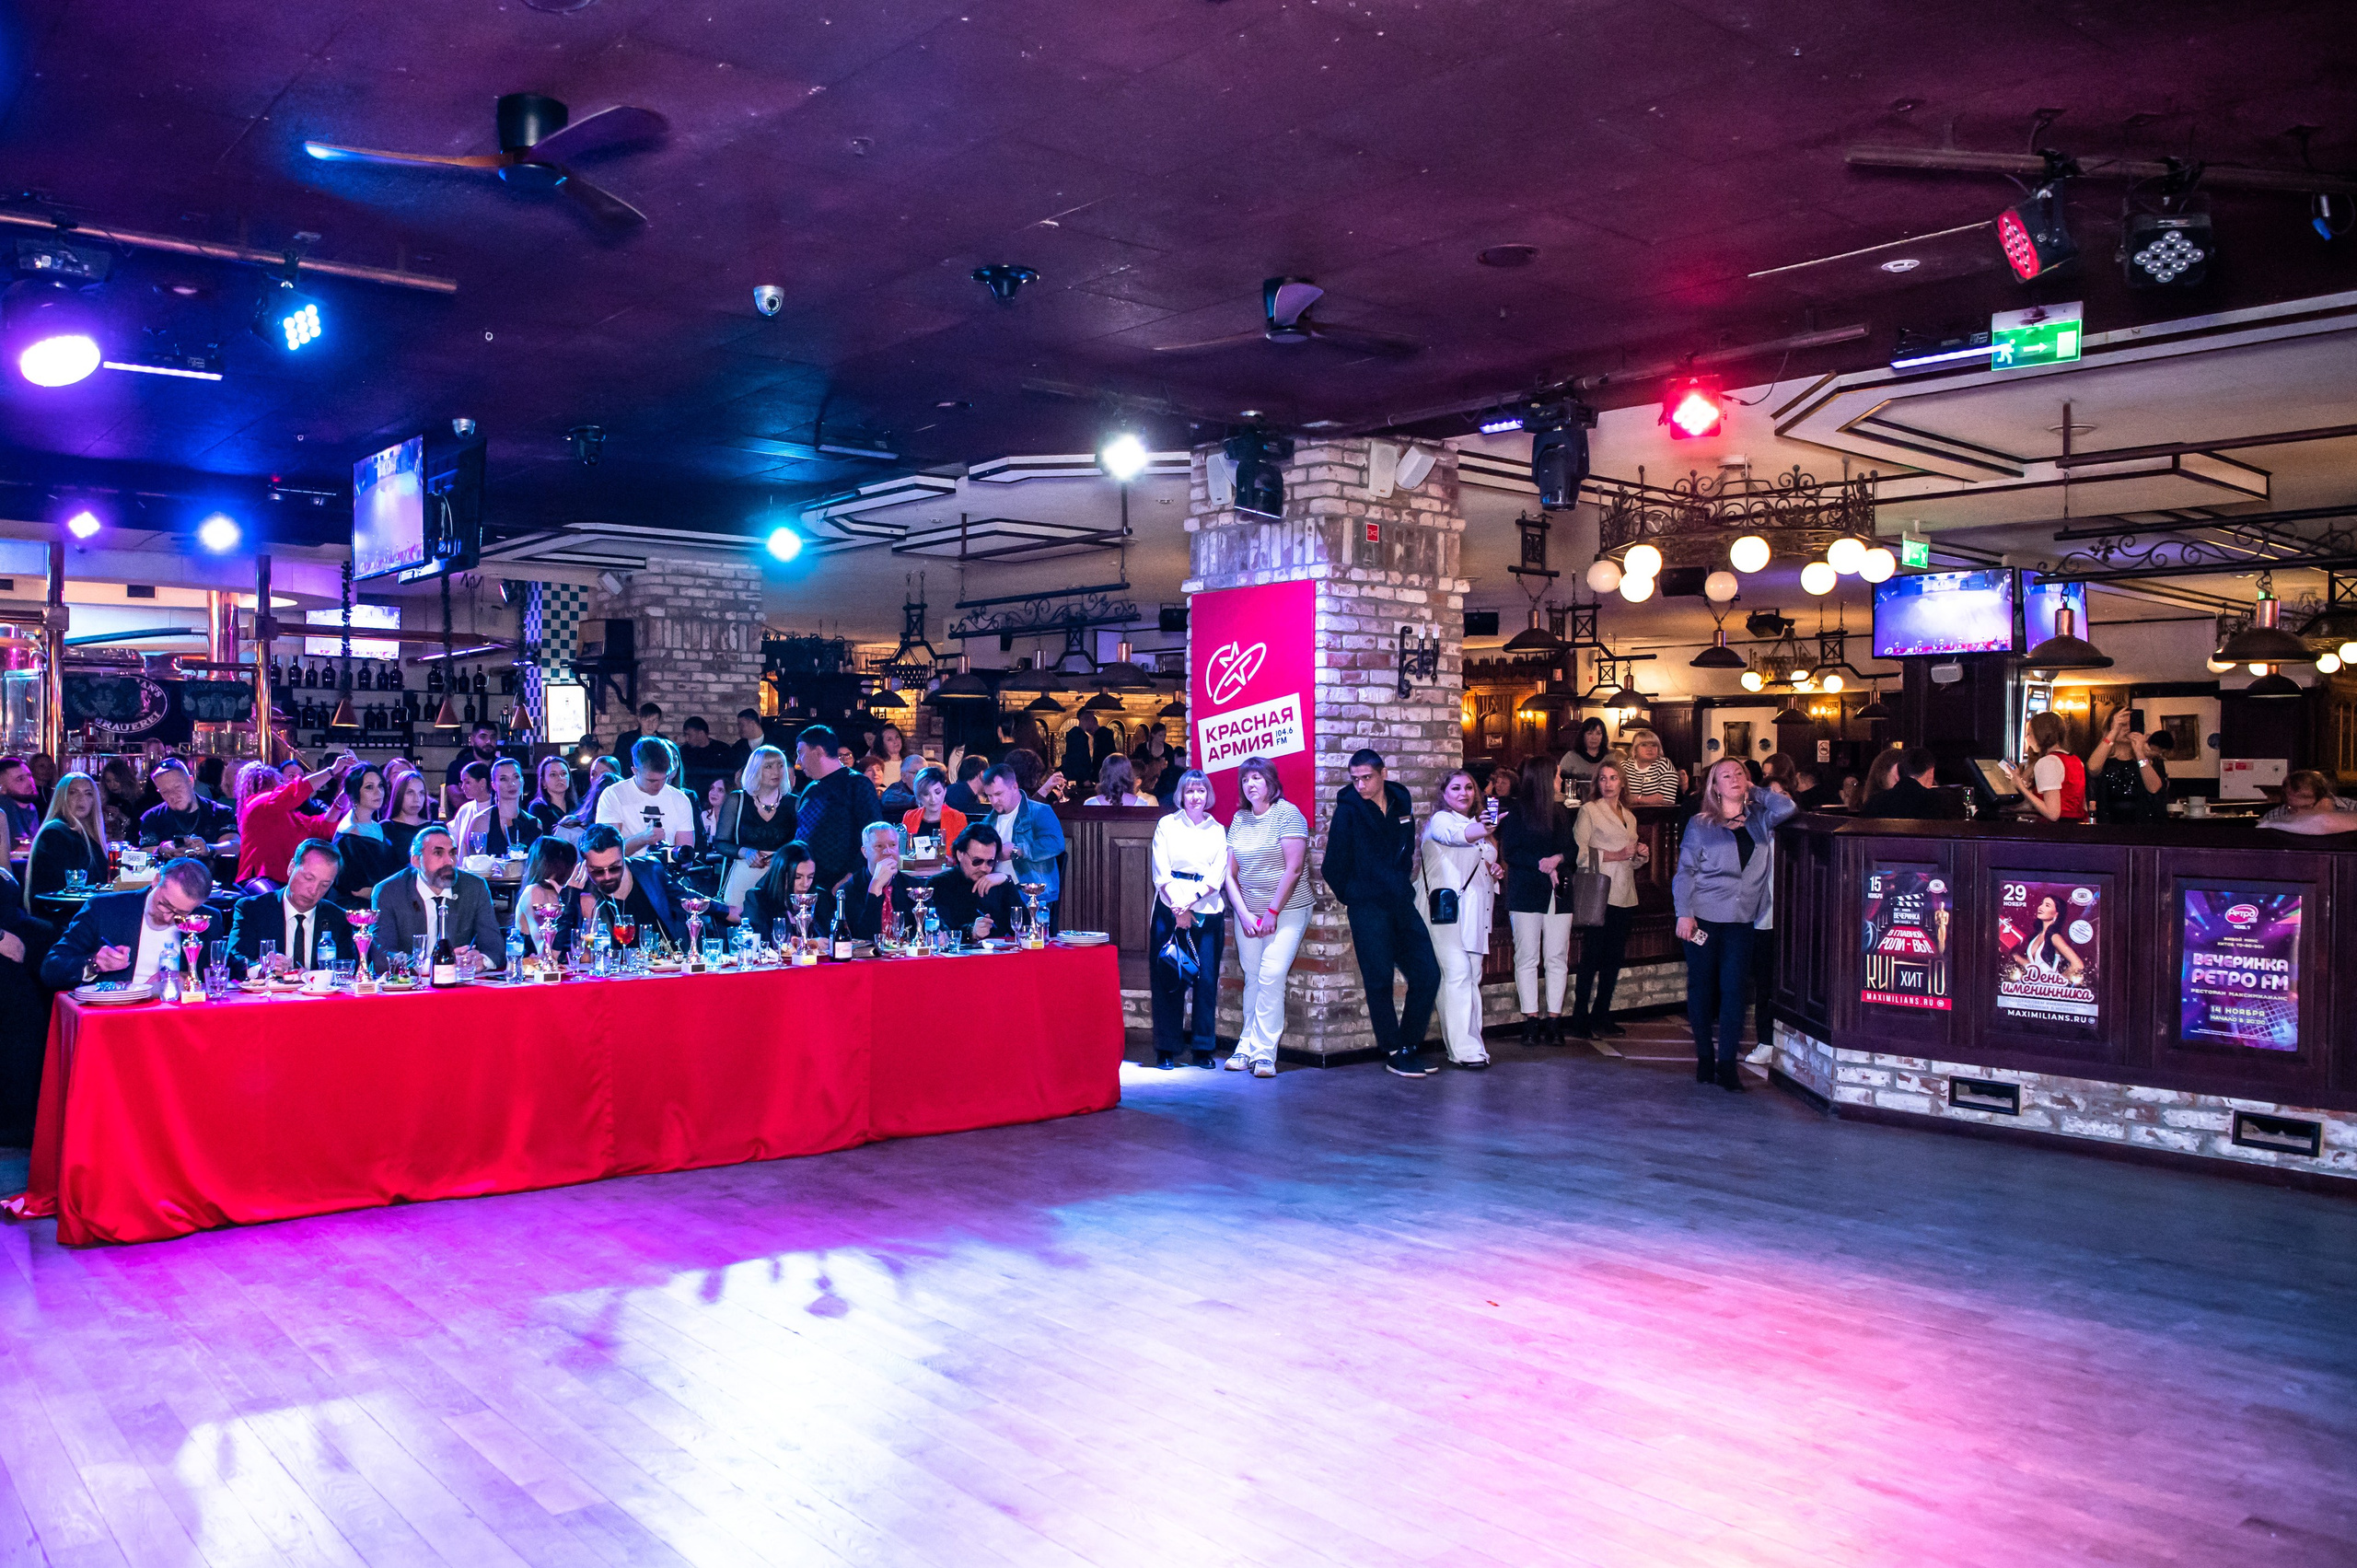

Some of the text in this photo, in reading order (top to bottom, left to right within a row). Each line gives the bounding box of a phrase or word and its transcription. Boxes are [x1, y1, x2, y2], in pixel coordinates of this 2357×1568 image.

[1205, 706, 1294, 743] КРАСНАЯ
[1208, 726, 1294, 762] АРМИЯ 104.6
[1276, 737, 1287, 745] FM
[1870, 877, 1882, 892] 15
[2003, 884, 2026, 901] 29
[1893, 929, 1925, 938] ГЛАВНОЙ
[1877, 937, 1906, 951] РОЛИ
[2193, 952, 2289, 972] ВЕЧЕРИНКА
[1900, 971, 1923, 987] ХИТ
[2024, 964, 2067, 985] День
[2191, 968, 2289, 991] РЕТРО FM
[2002, 981, 2094, 1002] именинника
[2190, 988, 2226, 996] РЕСТОРАН
[1866, 993, 1933, 1006] MAXIMILIANS.RU
[2008, 1009, 2086, 1023] MAXIMILIANS.RU
[2211, 1015, 2237, 1023] НАЧАЛО
[2225, 1007, 2265, 1017] НОЯБРЯ
